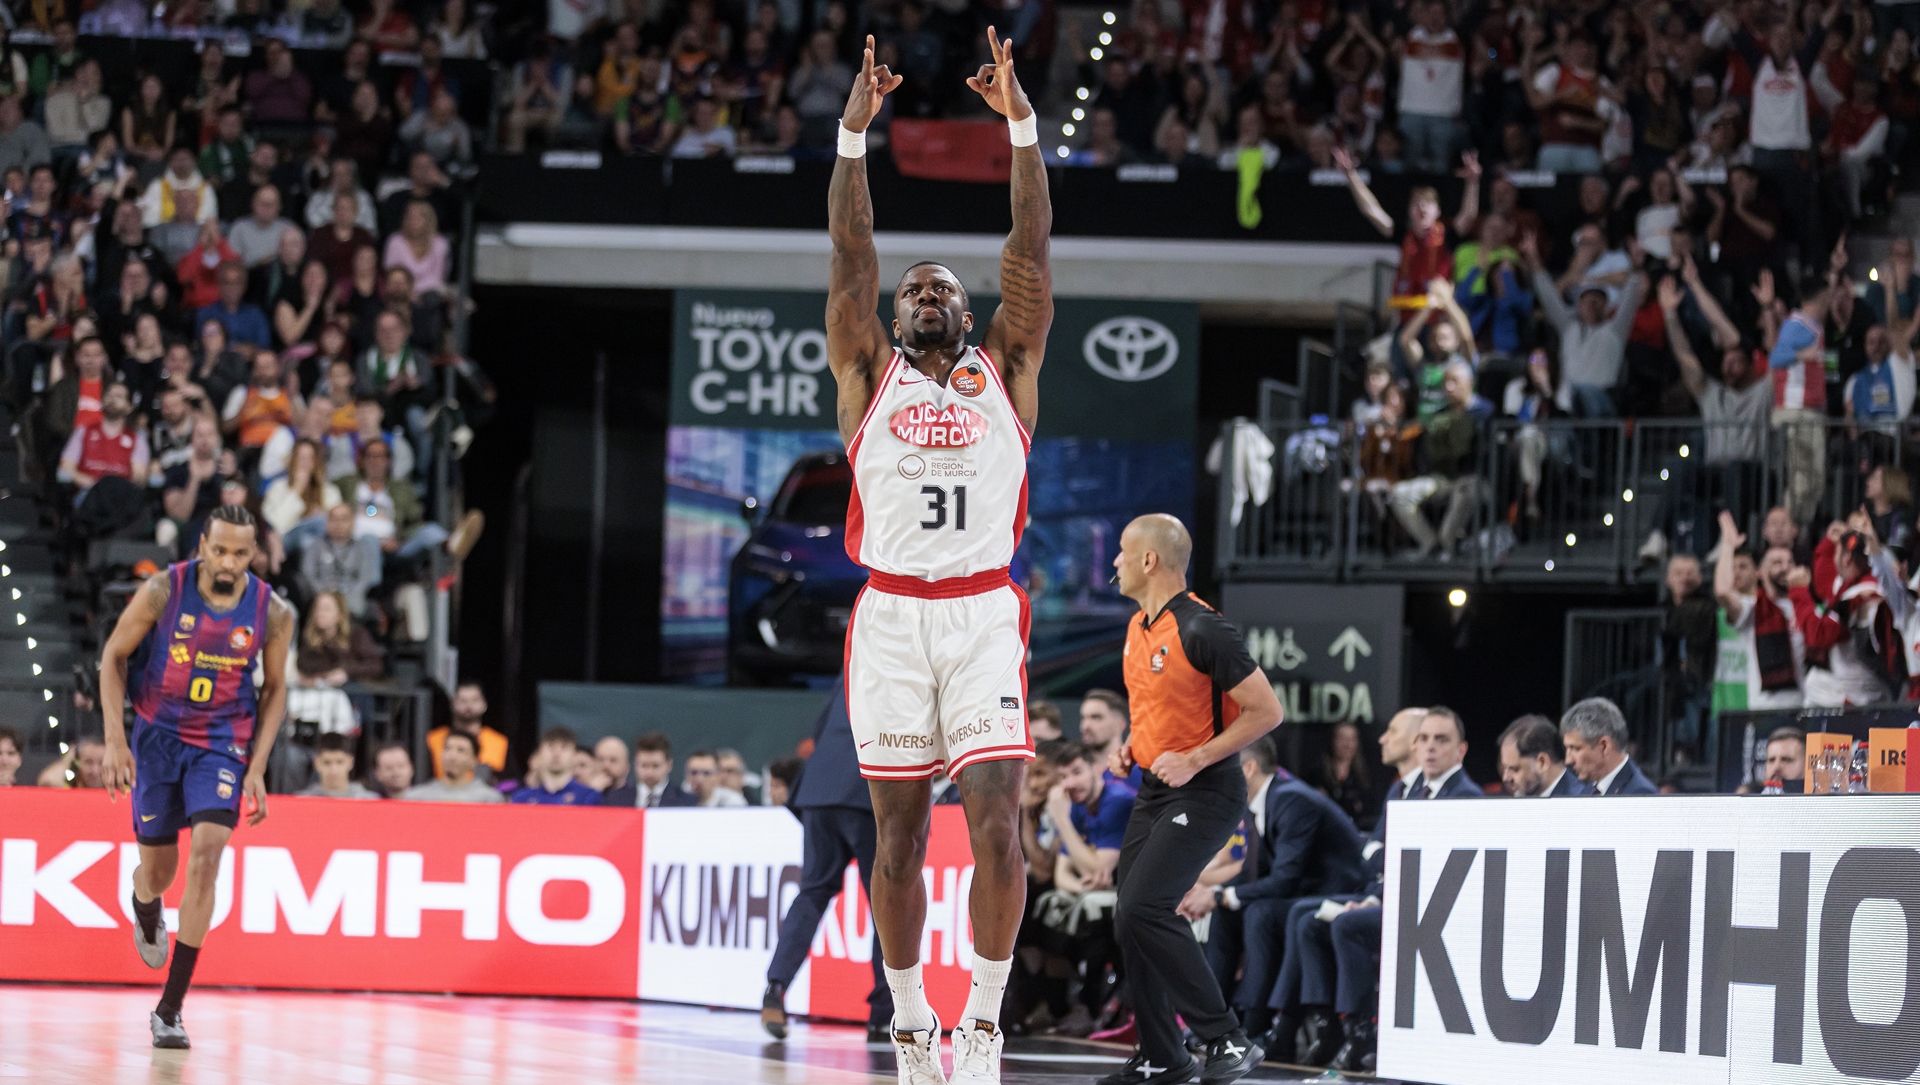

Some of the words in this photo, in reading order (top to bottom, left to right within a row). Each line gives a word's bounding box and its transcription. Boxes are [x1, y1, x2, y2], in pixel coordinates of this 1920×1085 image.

[692, 303, 775, 328] Nuevo
[692, 329, 828, 373] TOYO
[690, 370, 820, 417] C-HR
[909, 404, 971, 425] UCAM
[896, 425, 983, 446] MURCIA
[931, 462, 964, 470] REGIÓN
[931, 469, 943, 477] DE
[919, 484, 967, 531] 31
[190, 677, 213, 702] 0
[1272, 682, 1375, 723] ALIDA
[1, 838, 626, 946] KUMHO
[1394, 847, 1920, 1080] KUMHO
